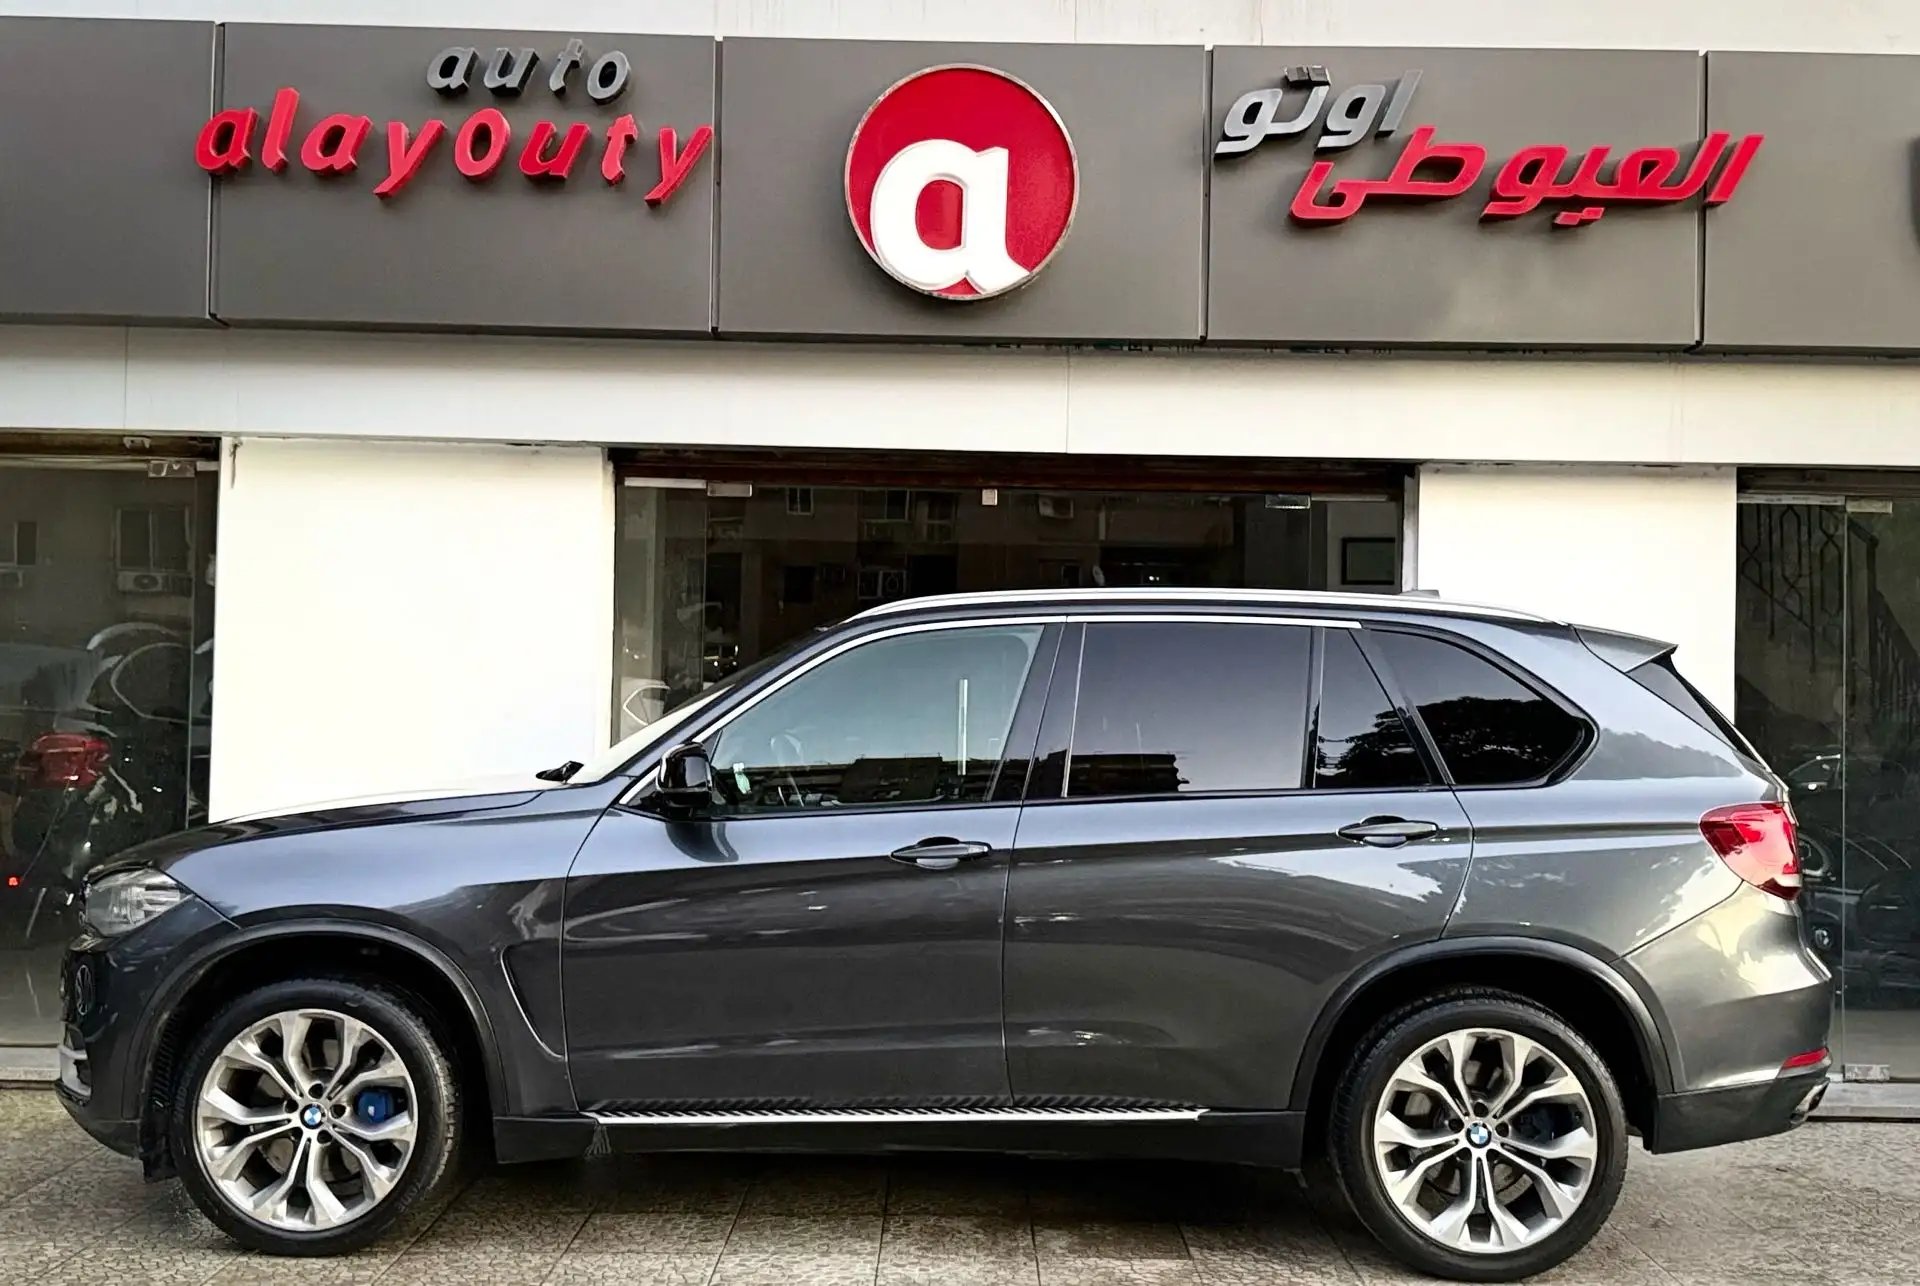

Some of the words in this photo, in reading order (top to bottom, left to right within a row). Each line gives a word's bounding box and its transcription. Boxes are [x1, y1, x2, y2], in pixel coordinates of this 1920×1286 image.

[427, 39, 633, 104] auto
[1214, 65, 1423, 158] اوتو
[195, 88, 713, 206] alayouty
[870, 138, 1031, 294] a
